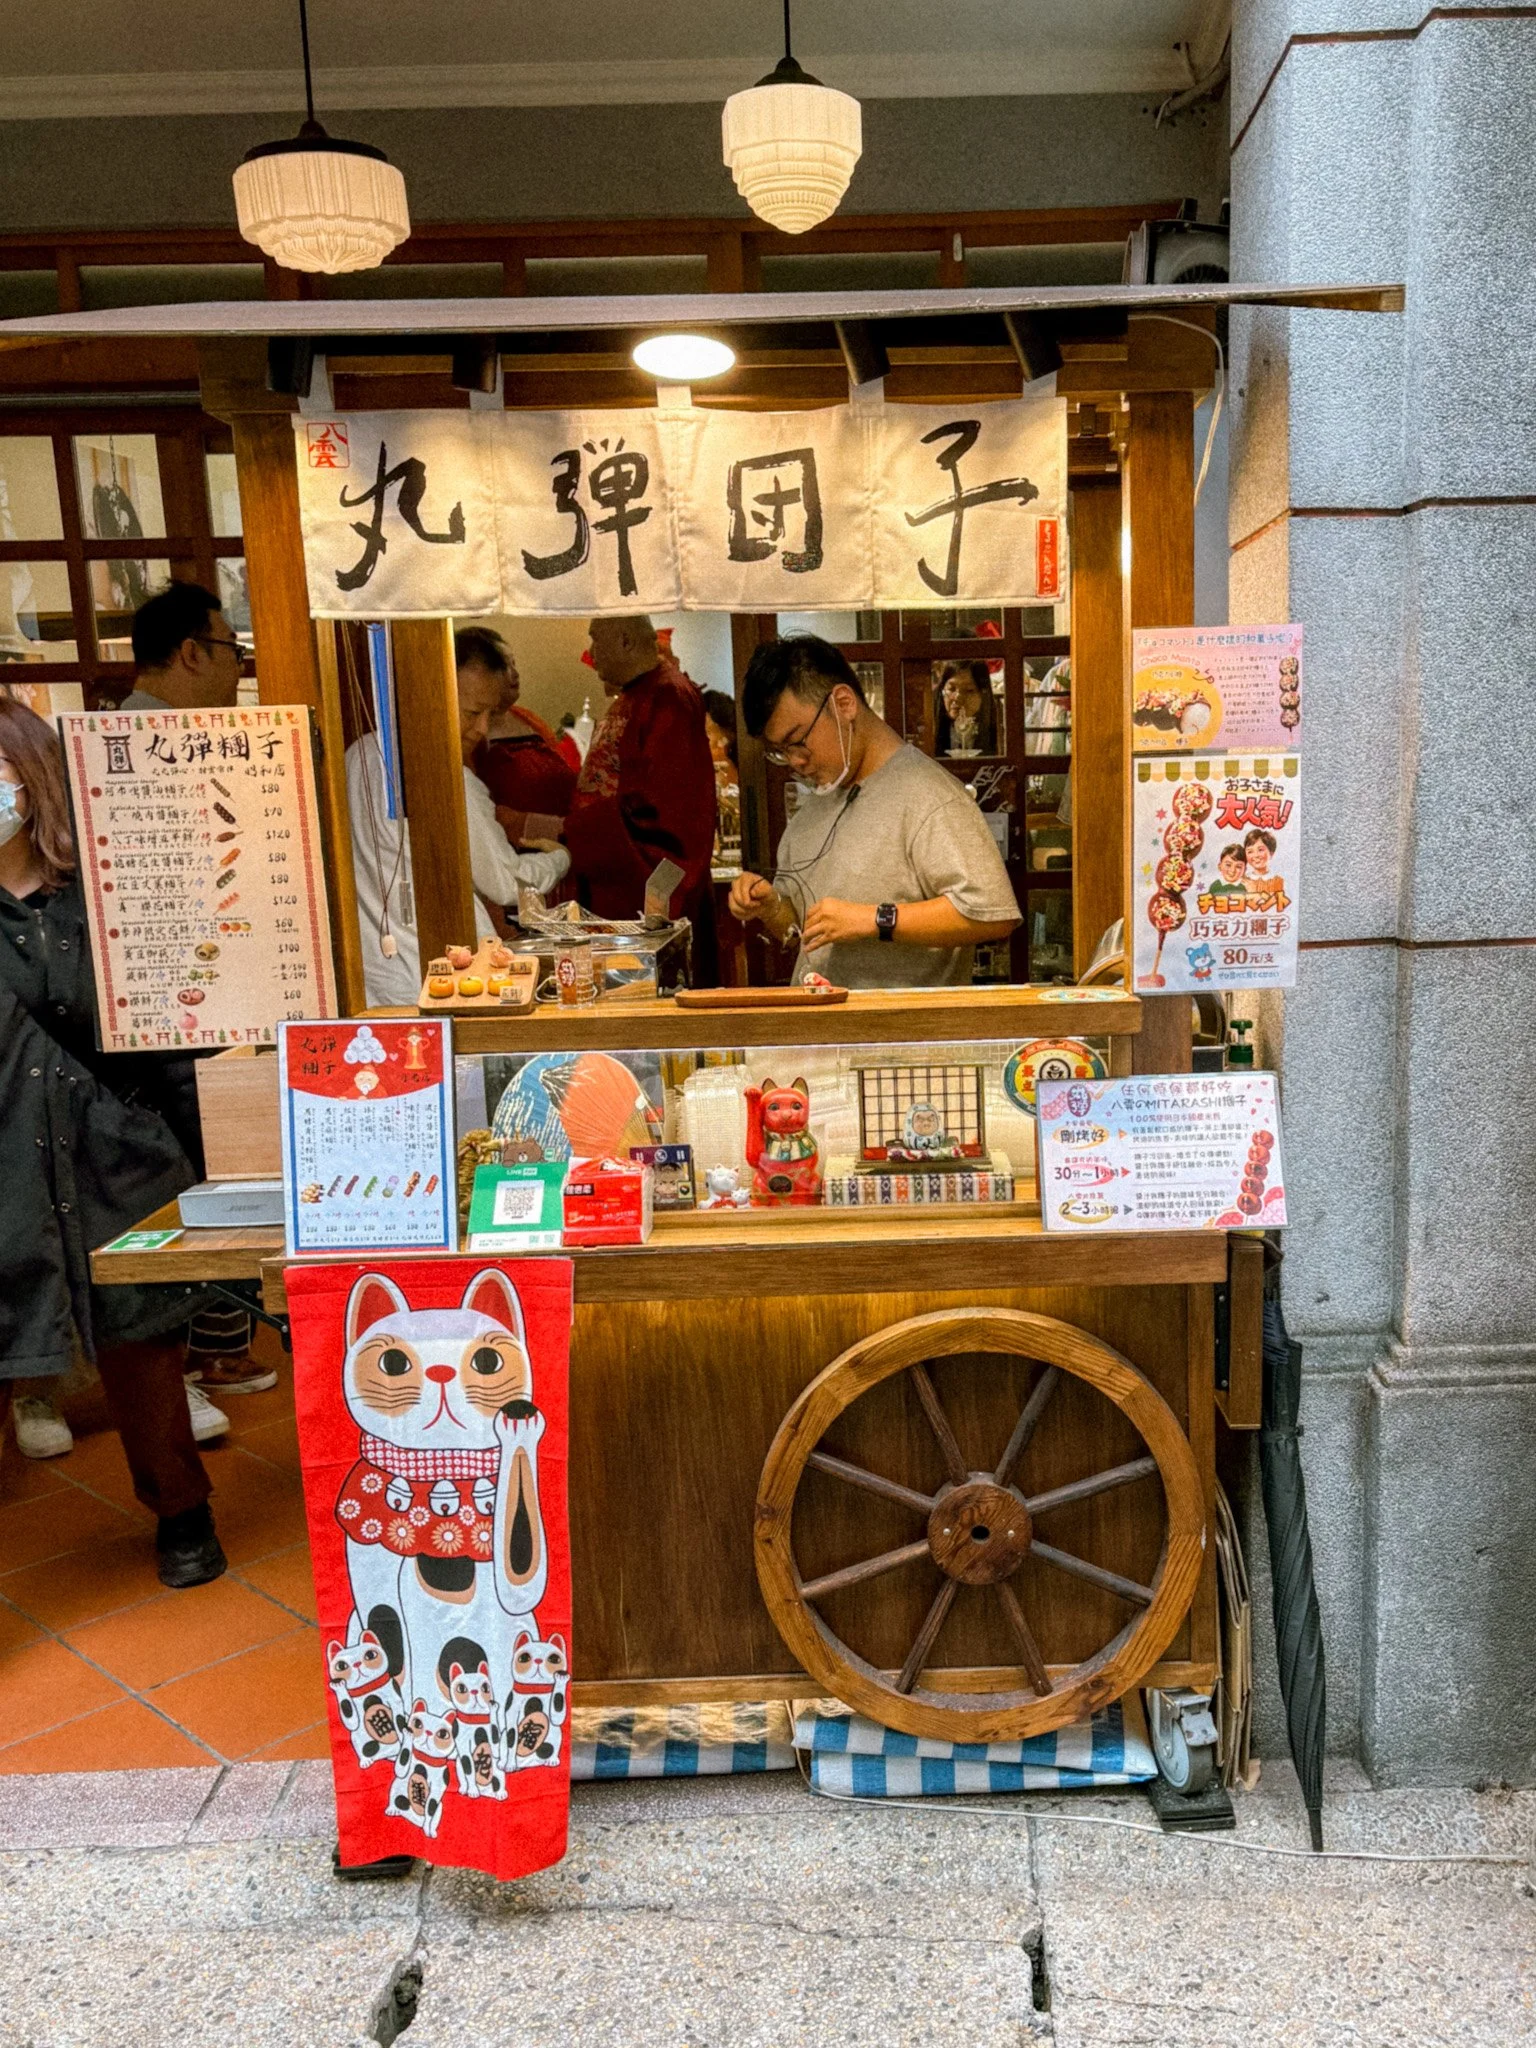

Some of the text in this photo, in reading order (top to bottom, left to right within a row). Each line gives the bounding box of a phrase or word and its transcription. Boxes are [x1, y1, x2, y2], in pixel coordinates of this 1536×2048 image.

[1225, 779, 1285, 796] お子さまに
[1215, 793, 1294, 830] 大人気!
[1197, 891, 1292, 914] チョコマント
